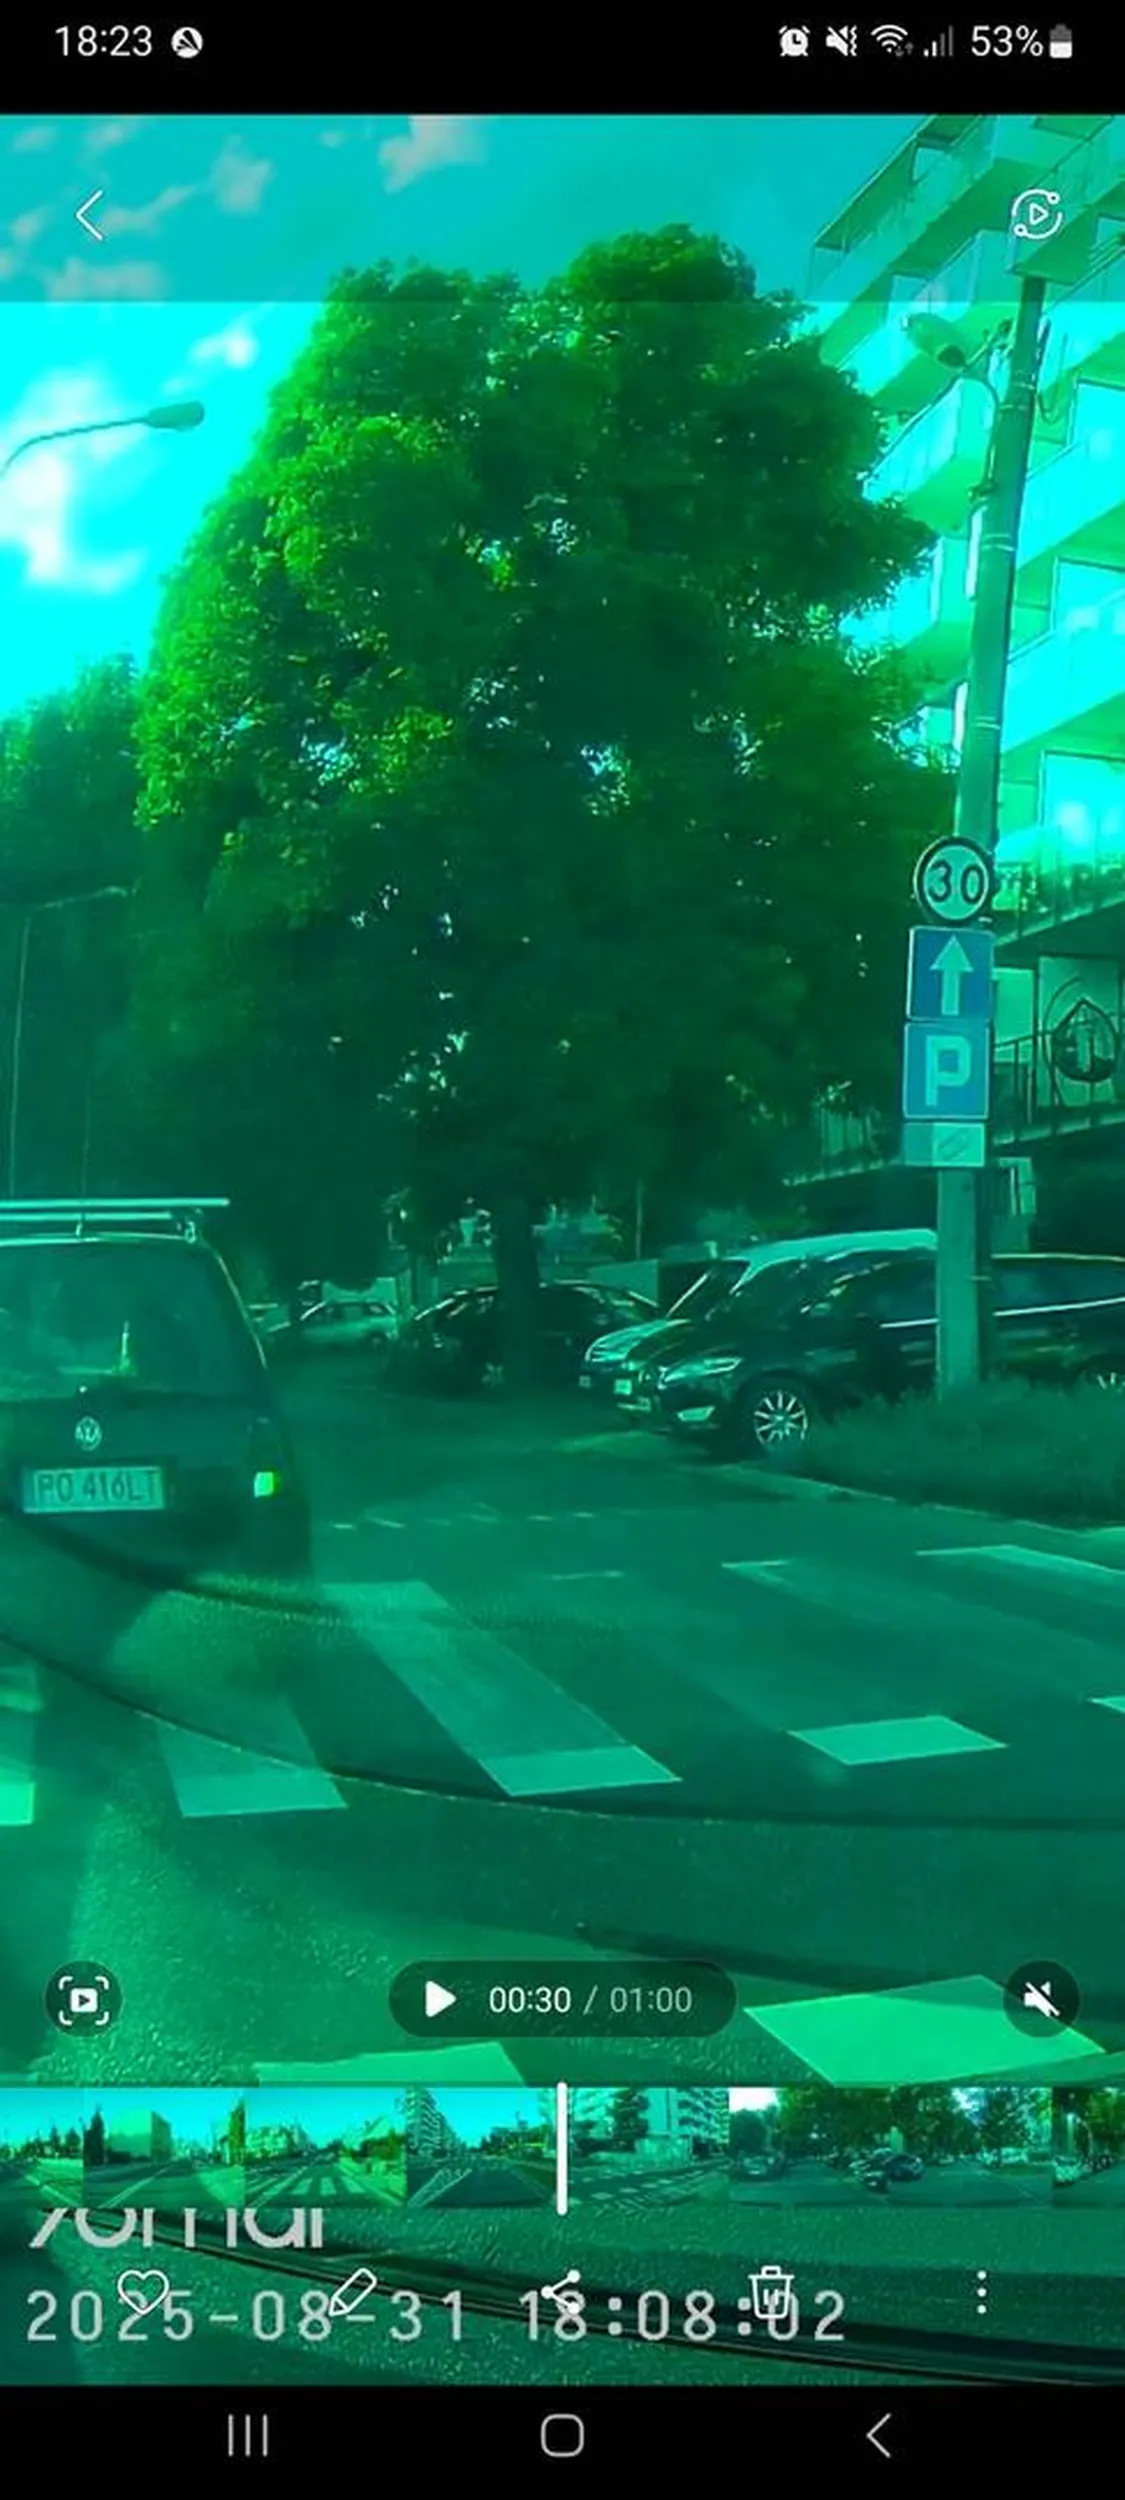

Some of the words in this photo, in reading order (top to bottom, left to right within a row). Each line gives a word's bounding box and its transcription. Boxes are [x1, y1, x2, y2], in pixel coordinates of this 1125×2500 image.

[55, 25, 152, 56] 18:23
[971, 25, 1043, 56] 53%
[928, 858, 983, 905] 30
[925, 1034, 971, 1106] P
[489, 1986, 571, 2013] 00:30
[609, 1986, 693, 2013] 01:00
